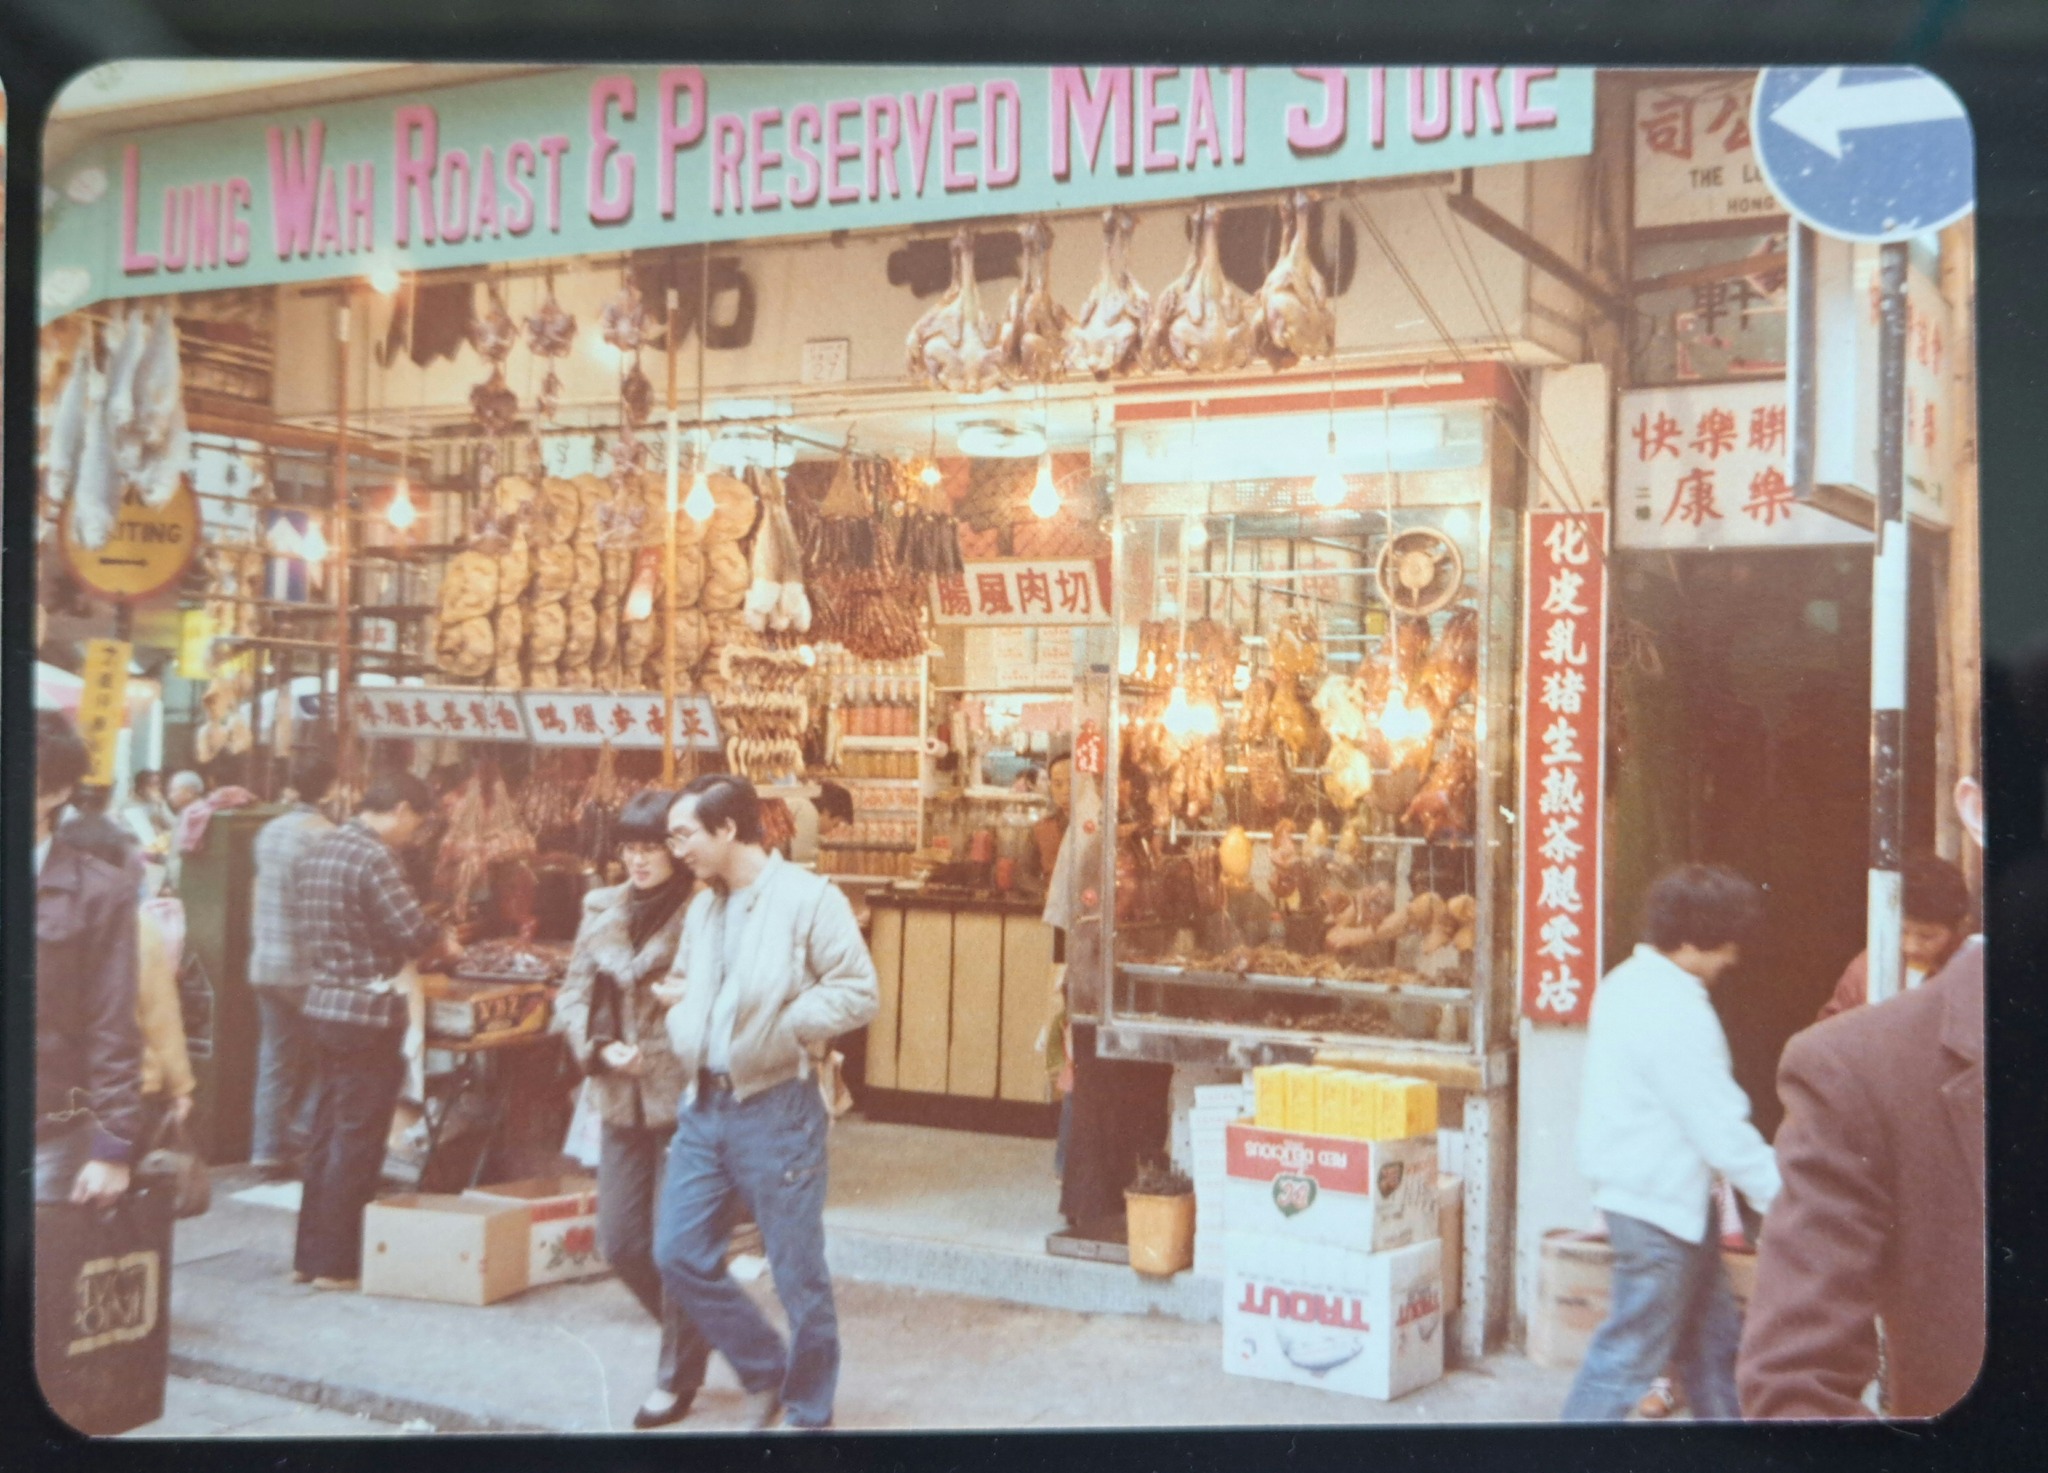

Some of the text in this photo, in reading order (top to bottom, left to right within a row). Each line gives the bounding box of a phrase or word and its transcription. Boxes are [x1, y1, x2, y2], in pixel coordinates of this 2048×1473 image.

[121, 142, 252, 275] LUNG
[266, 119, 375, 260] WAH
[394, 104, 570, 247] ROAST
[588, 74, 638, 226] &
[657, 65, 1022, 219] PRESERVED
[1050, 66, 1246, 182] MEAT
[1688, 164, 1724, 189] THE
[1726, 194, 1775, 213] HONG
[1317, 1150, 1348, 1169] RED
[1238, 1282, 1370, 1332] TROUT
